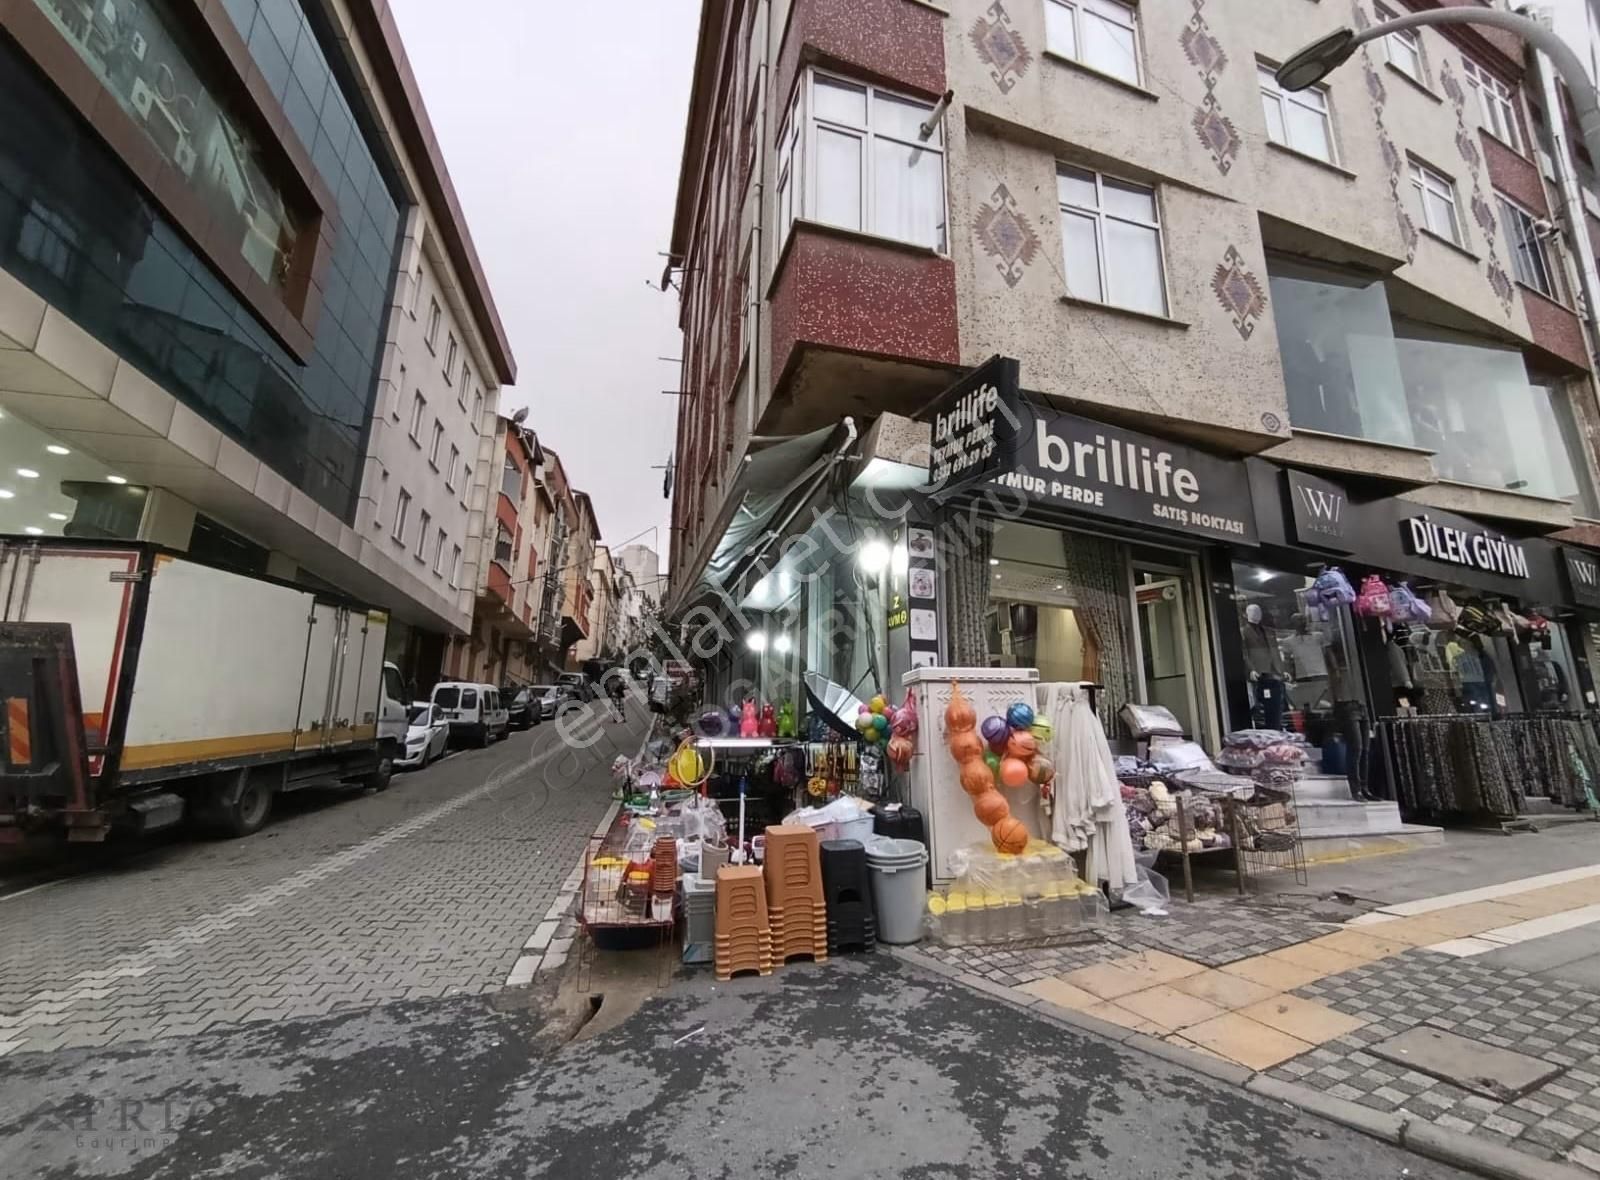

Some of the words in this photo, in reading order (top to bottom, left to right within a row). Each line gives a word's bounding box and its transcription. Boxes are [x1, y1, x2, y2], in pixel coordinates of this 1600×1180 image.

[936, 383, 999, 441] brillife
[1037, 419, 1199, 503] brillife
[1051, 481, 1104, 507] PERDE
[1152, 503, 1188, 526] SATIŞ
[1191, 513, 1245, 535] NOKTASI
[1410, 514, 1474, 567] DİLEK
[1475, 534, 1530, 578] GİYİM
